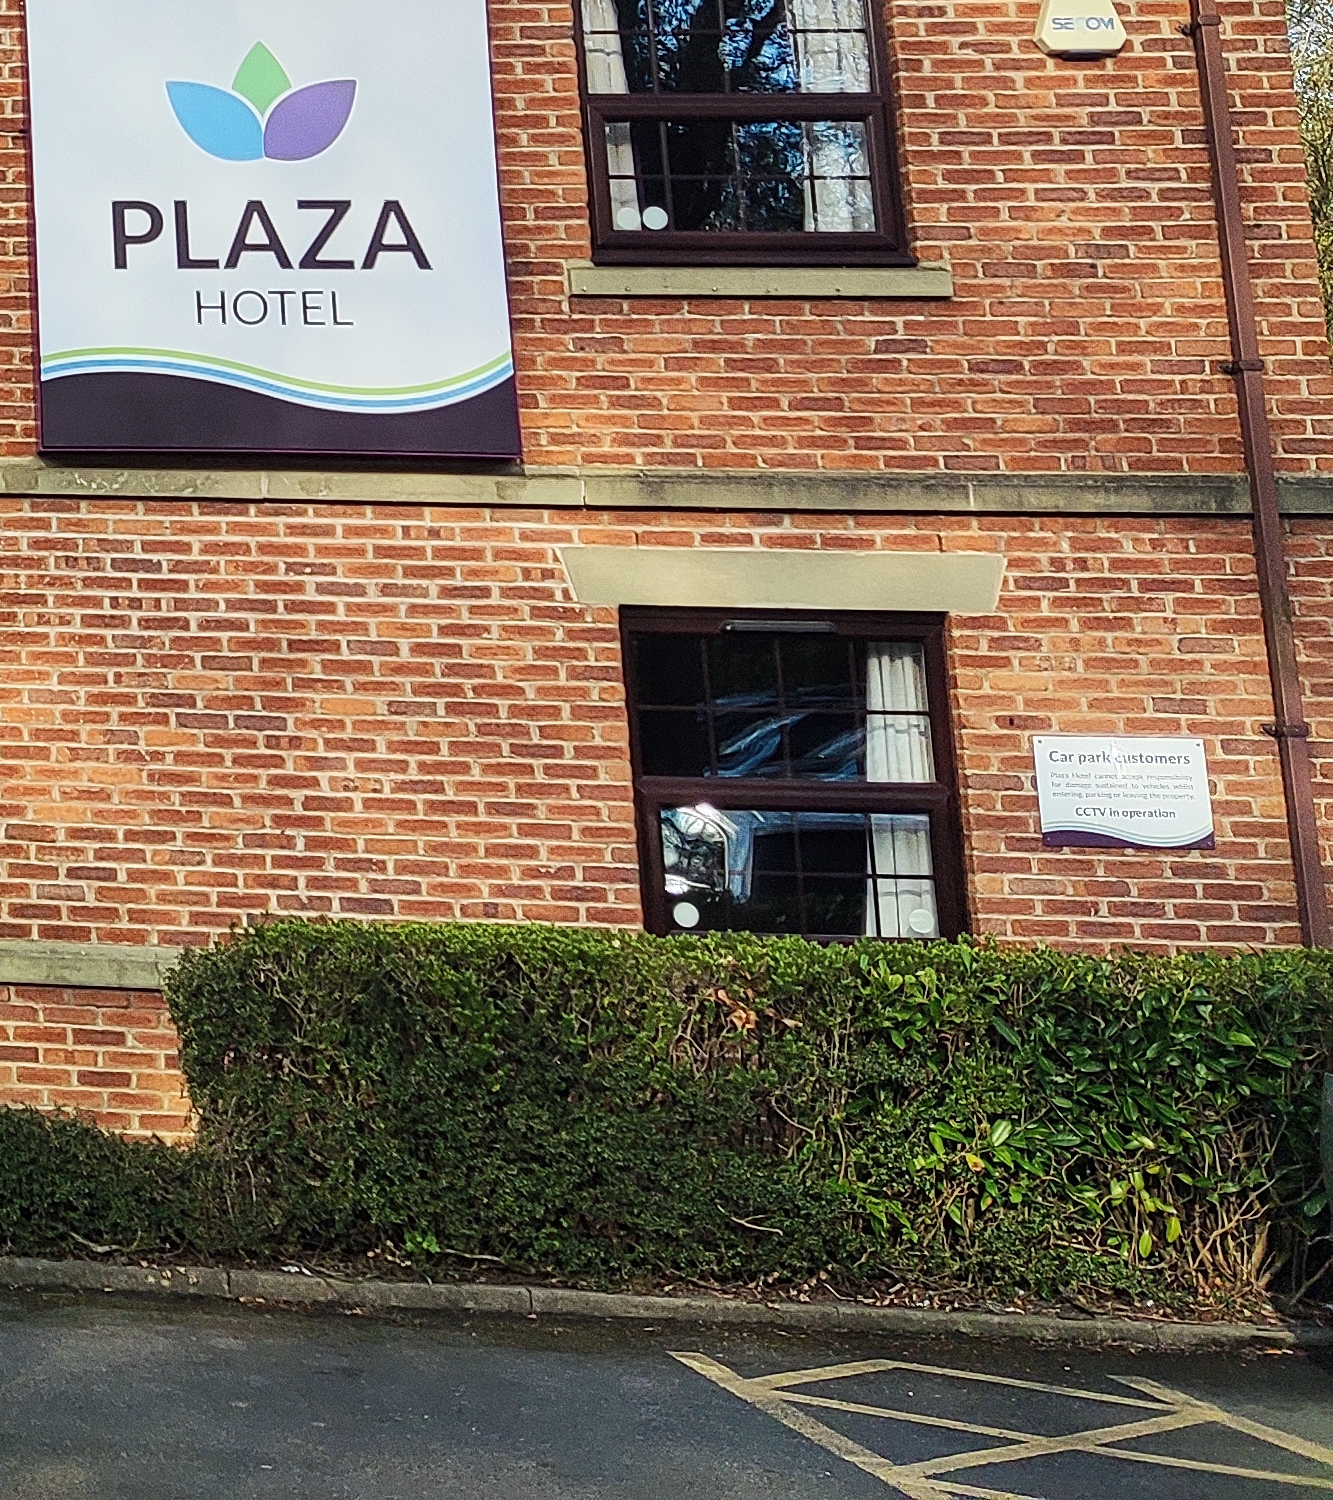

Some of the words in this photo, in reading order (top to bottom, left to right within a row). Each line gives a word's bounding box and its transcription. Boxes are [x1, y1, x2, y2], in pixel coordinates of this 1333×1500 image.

[1051, 16, 1115, 31] SEOM
[111, 199, 433, 271] PLAZA
[195, 290, 354, 326] HOTEL
[1049, 750, 1075, 763] Car
[1078, 750, 1112, 765] park
[1115, 752, 1191, 765] customers
[1075, 807, 1107, 817] CCTV
[1109, 806, 1120, 817] in
[1121, 808, 1176, 819] operation
